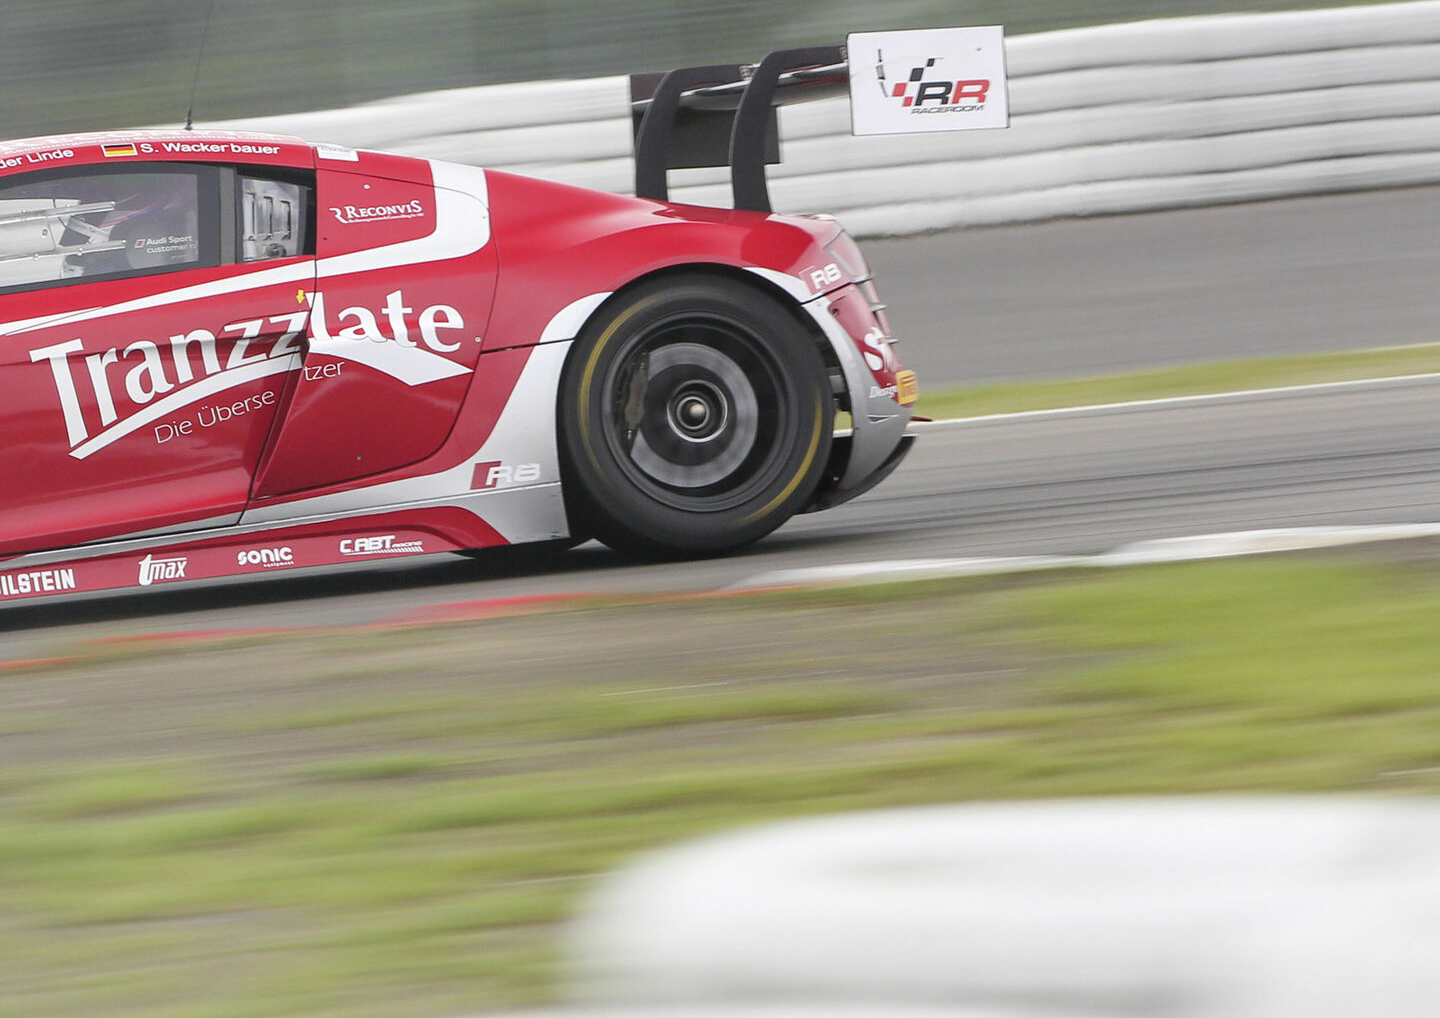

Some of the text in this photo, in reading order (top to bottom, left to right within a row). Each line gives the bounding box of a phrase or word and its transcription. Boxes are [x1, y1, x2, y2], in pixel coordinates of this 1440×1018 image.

[915, 79, 990, 106] RR
[26, 148, 74, 164] Linde
[139, 142, 160, 153] S.
[29, 289, 465, 450] Tranzzlate
[153, 419, 193, 444] Die
[485, 462, 541, 487] R8
